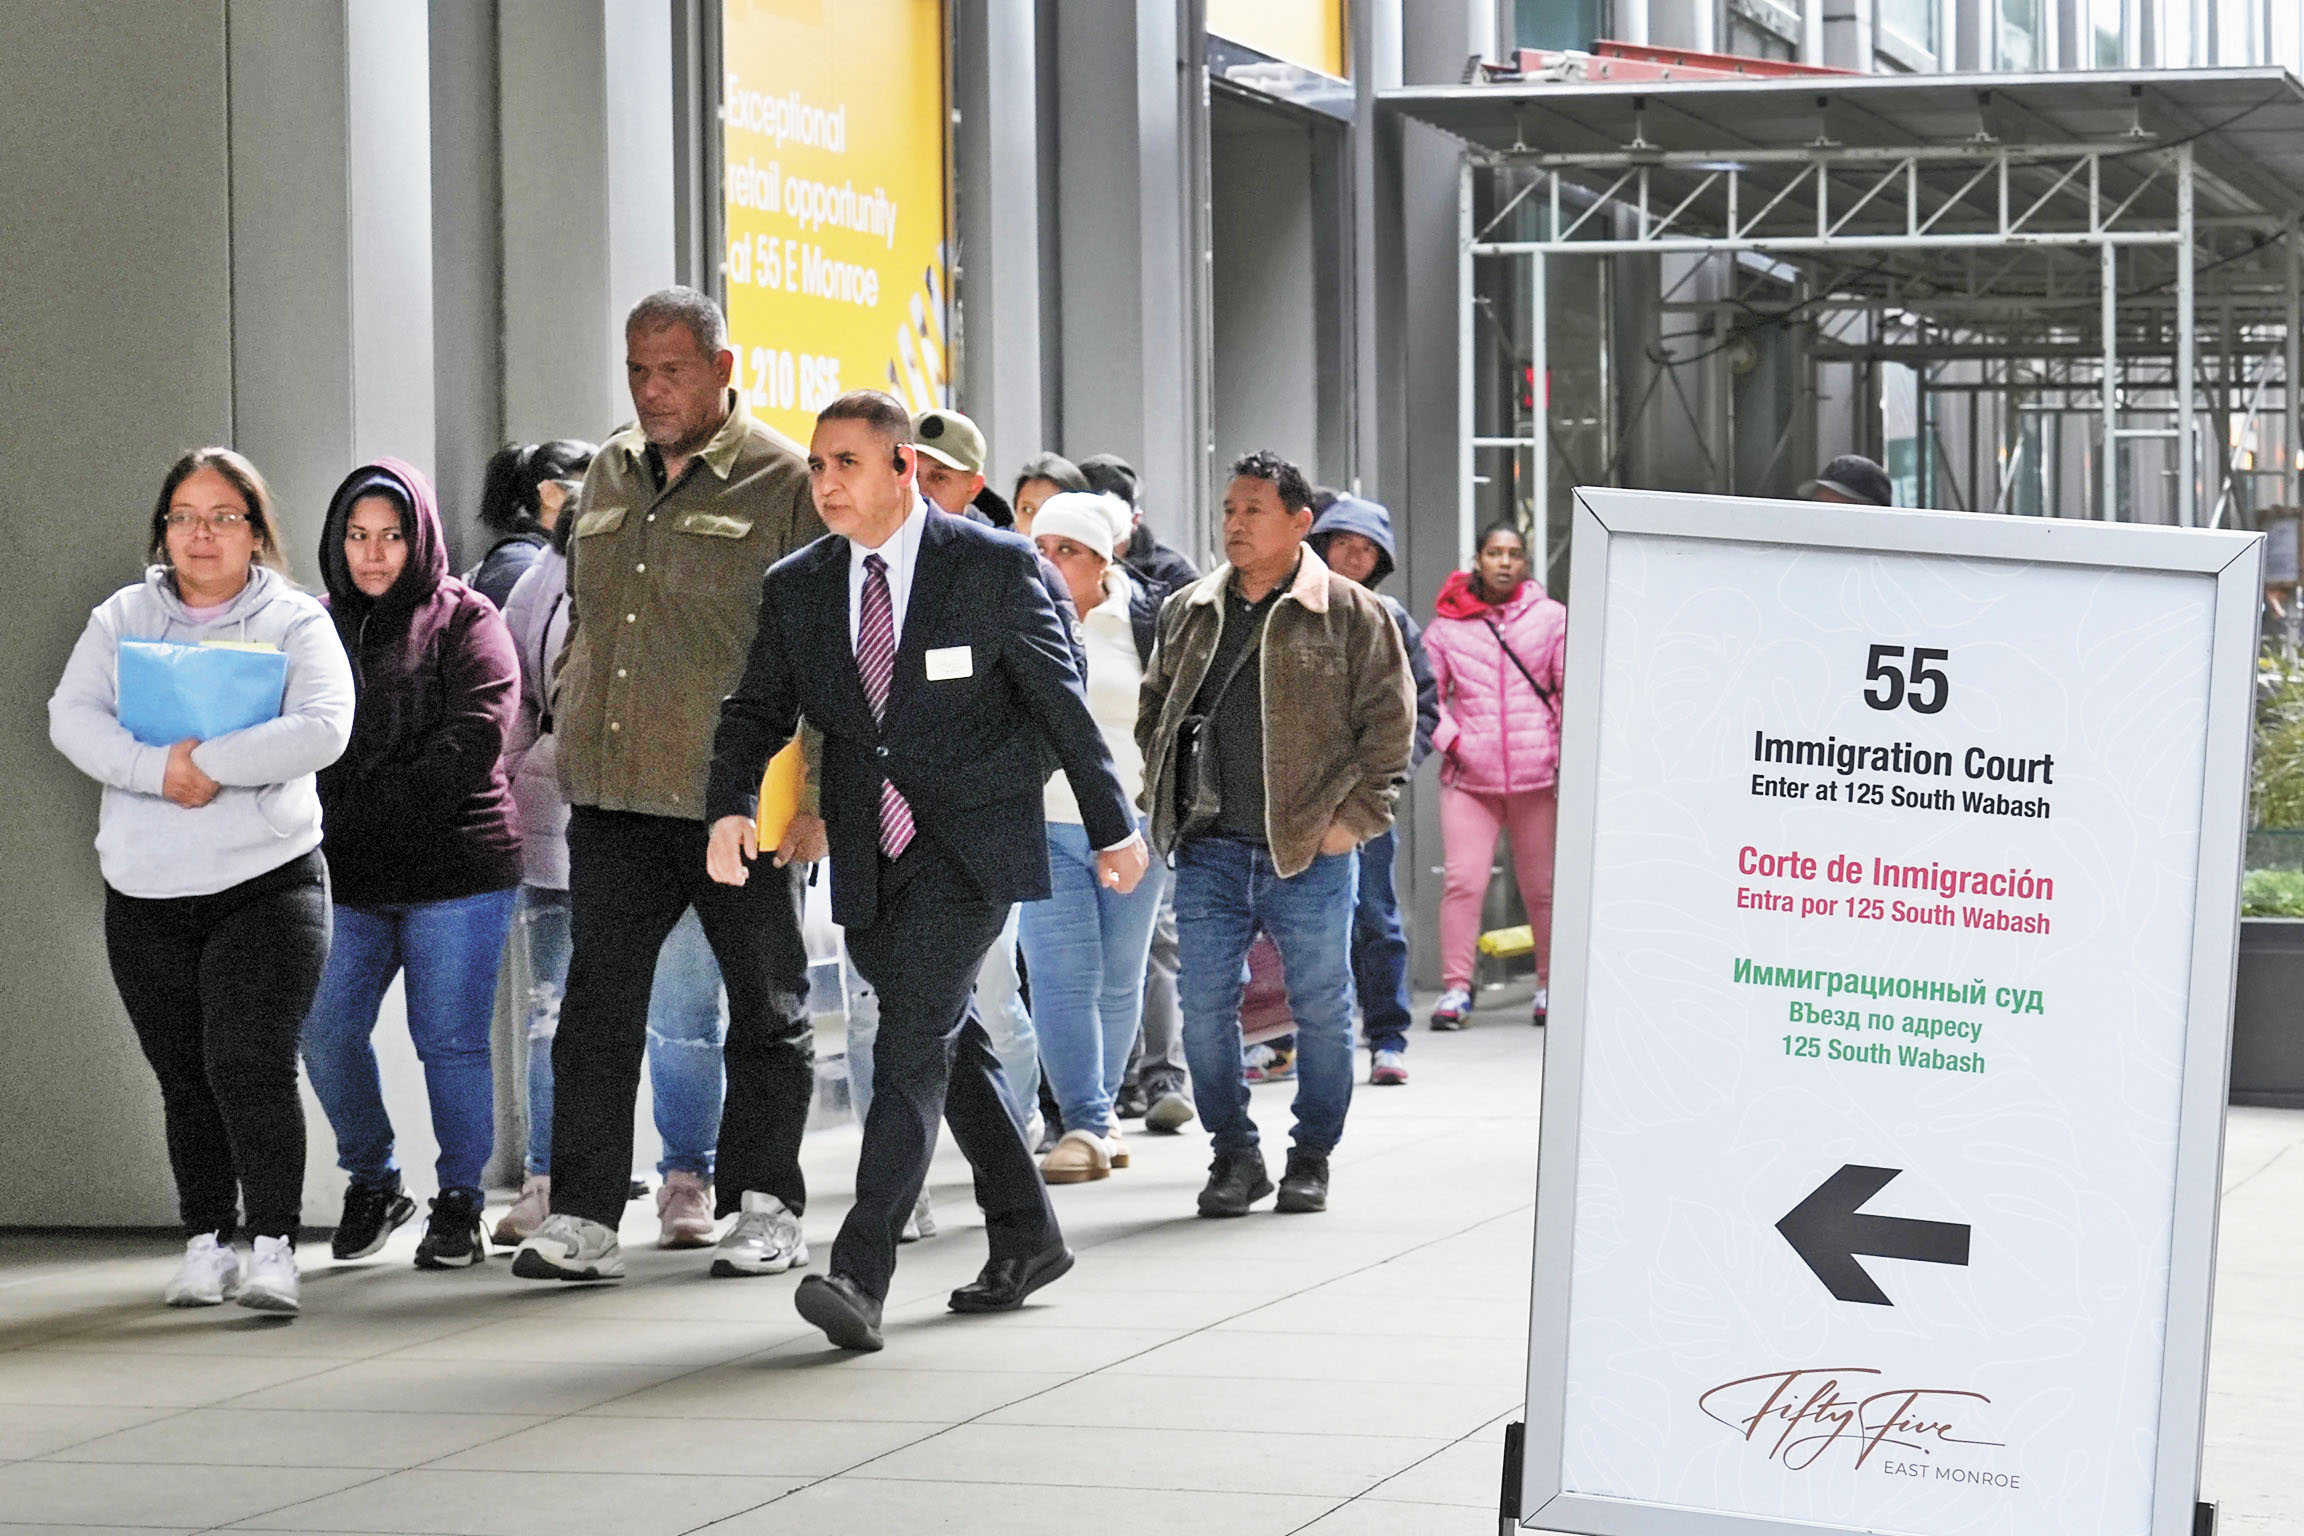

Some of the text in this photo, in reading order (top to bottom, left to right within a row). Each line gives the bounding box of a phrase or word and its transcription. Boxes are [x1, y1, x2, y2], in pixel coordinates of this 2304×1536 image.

[727, 73, 846, 153] Exceptional
[728, 156, 897, 250] retail opportunity
[730, 231, 880, 307] at 55 E Monroe
[1863, 643, 1949, 715] 55
[1754, 730, 2055, 785] Immigration Court
[1751, 773, 2051, 820] Enter at 125 South Wabash
[1738, 845, 2054, 901] Corte de Inmigración
[1736, 886, 2051, 935] Entra por 125 South Wabash
[1733, 957, 2045, 1015] Иммиграционный суд
[1782, 1034, 1985, 1074] 125 South Wabash
[1867, 1013, 1895, 1031] по
[1901, 1015, 1983, 1044] адресу
[1699, 1367, 2006, 1470] Fifty Five
[1884, 1460, 2020, 1490] EAST MONROE
